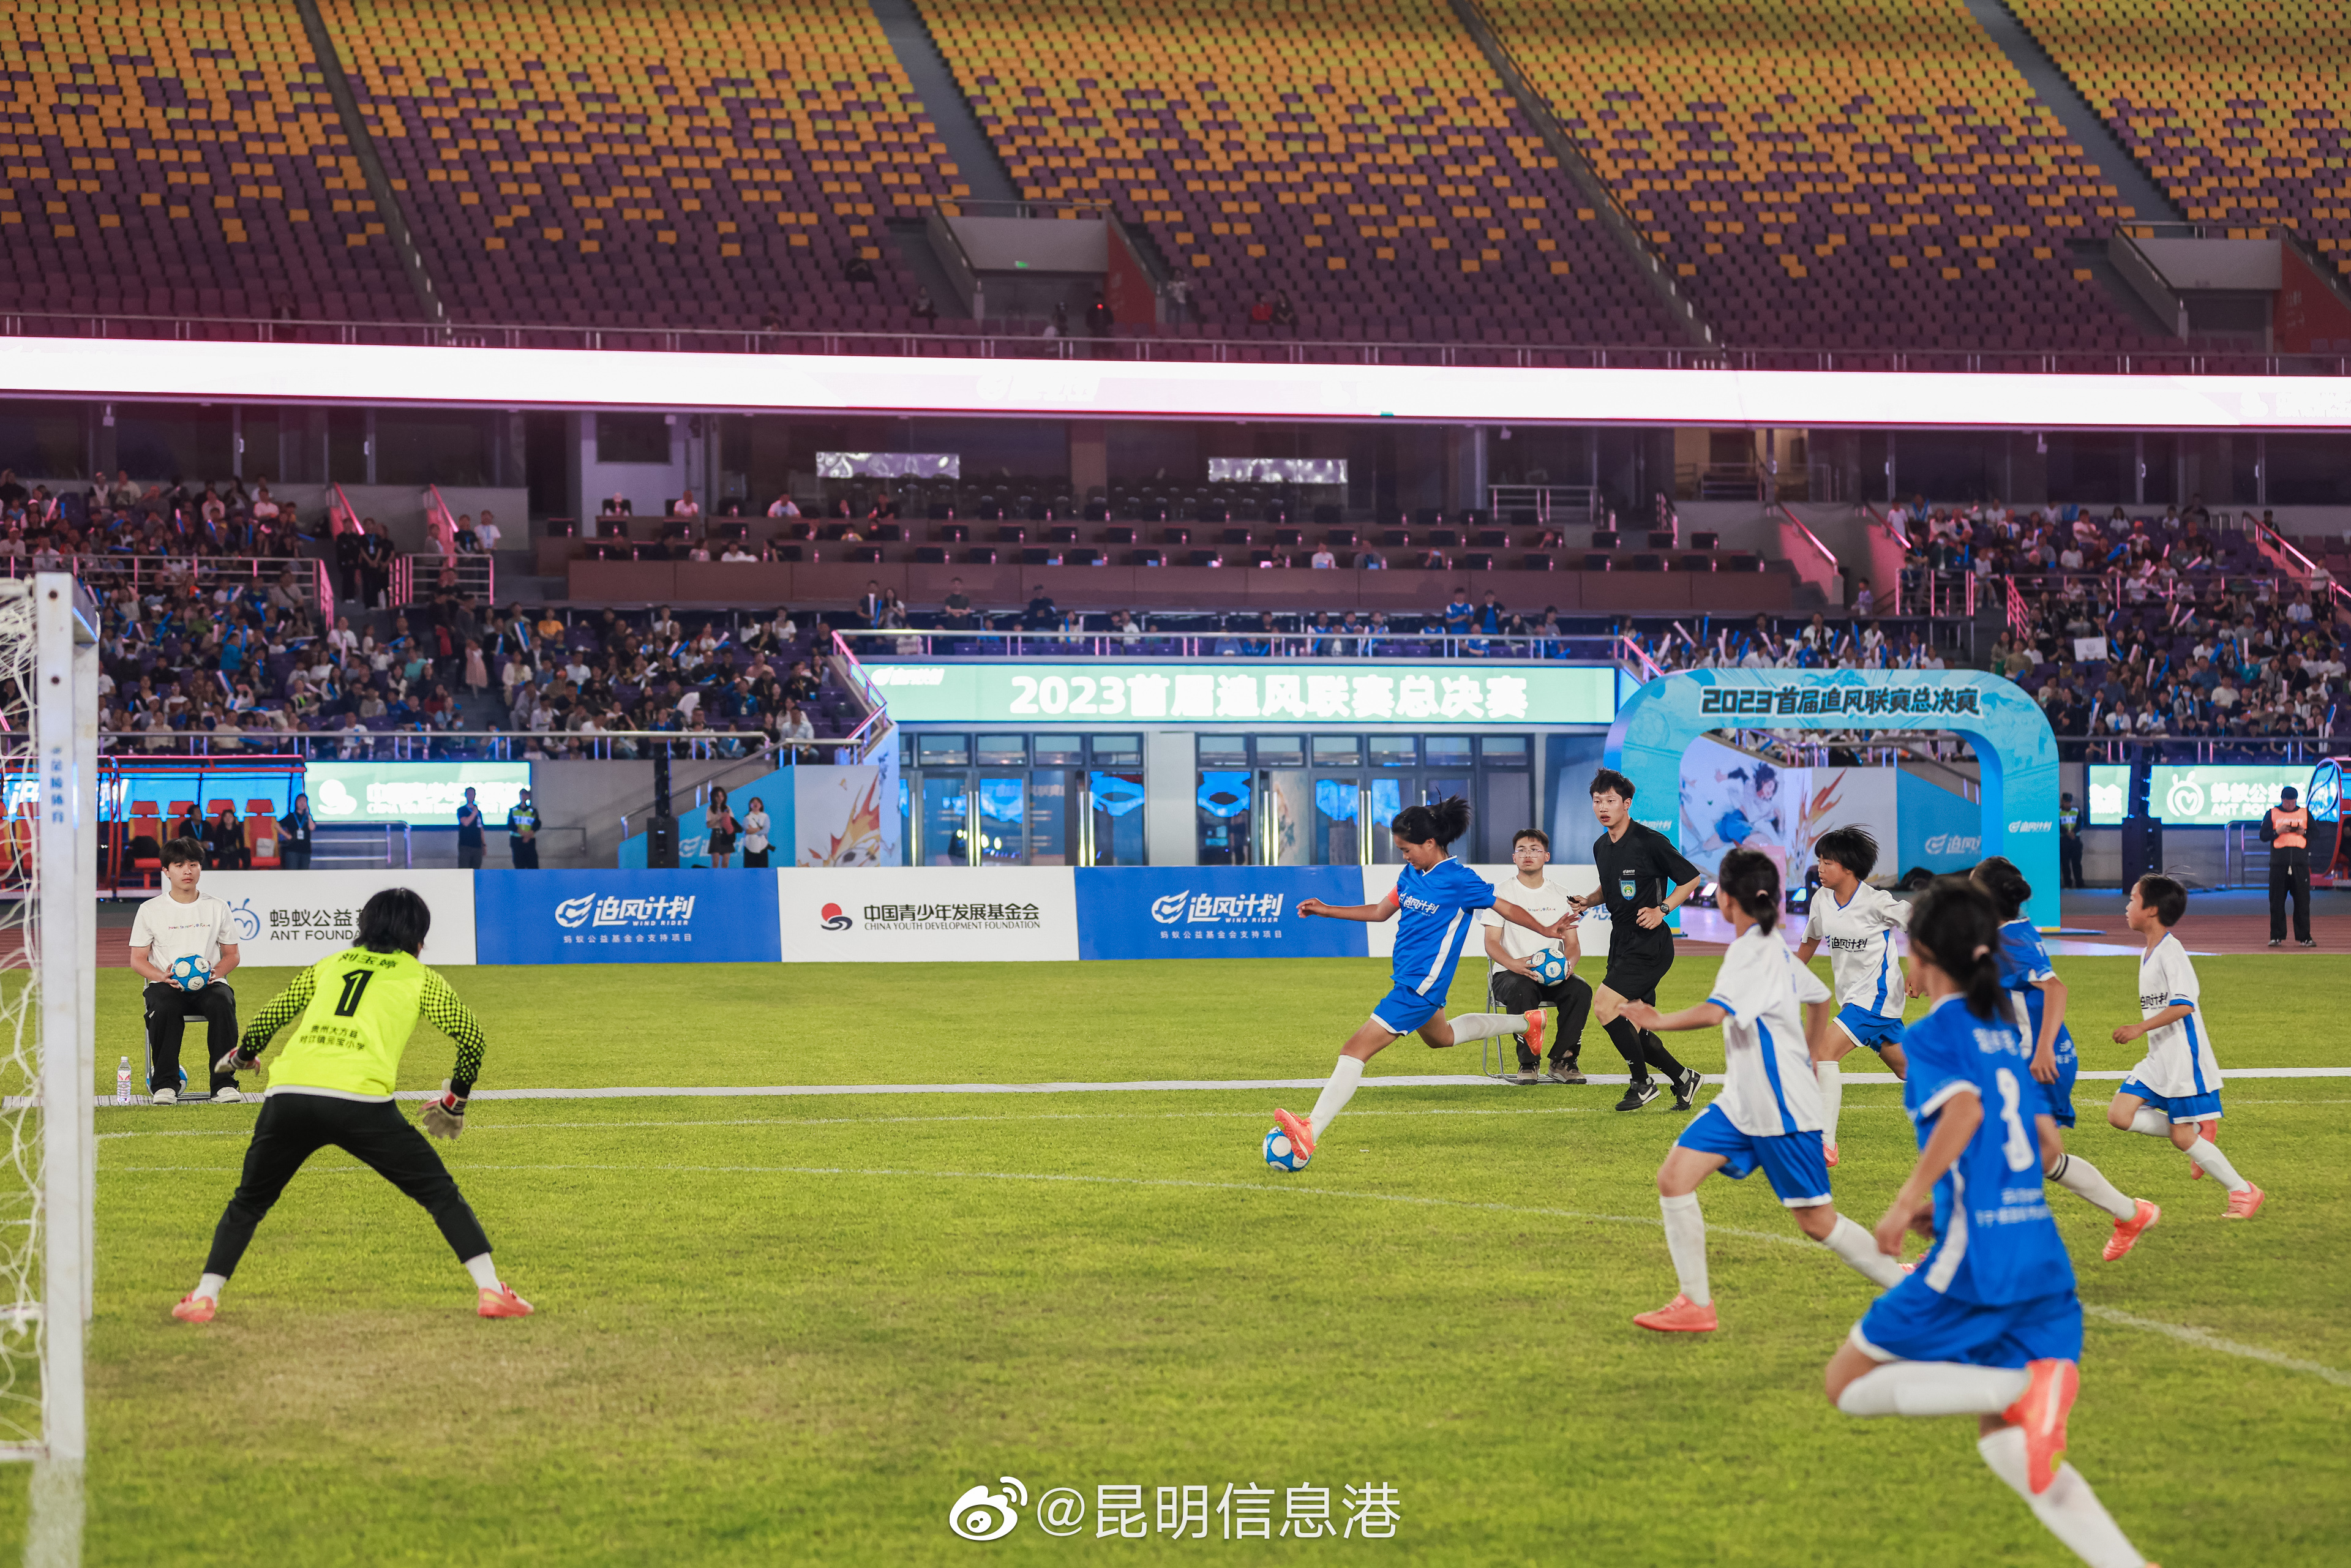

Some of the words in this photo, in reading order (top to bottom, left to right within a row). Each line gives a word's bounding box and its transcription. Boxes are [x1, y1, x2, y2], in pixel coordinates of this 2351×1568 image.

[1009, 674, 1528, 719] 2023首届追风联赛总决赛
[1701, 686, 1980, 715] 2023首届追风联赛总决赛
[592, 896, 696, 927] 追风计划
[864, 903, 1040, 921] 中国青少年发展基金会
[1187, 893, 1284, 923] 追风计划
[1403, 896, 1440, 914] 追风计划
[984, 921, 1040, 929] FOUNDATION
[270, 930, 299, 940] ANT
[563, 933, 692, 943] 蚂蚁公益基金会支持项目
[1160, 930, 1282, 939] 蚂蚁公益基金会支持项目
[1831, 937, 1868, 949] 追风计划
[334, 969, 374, 1017] 1
